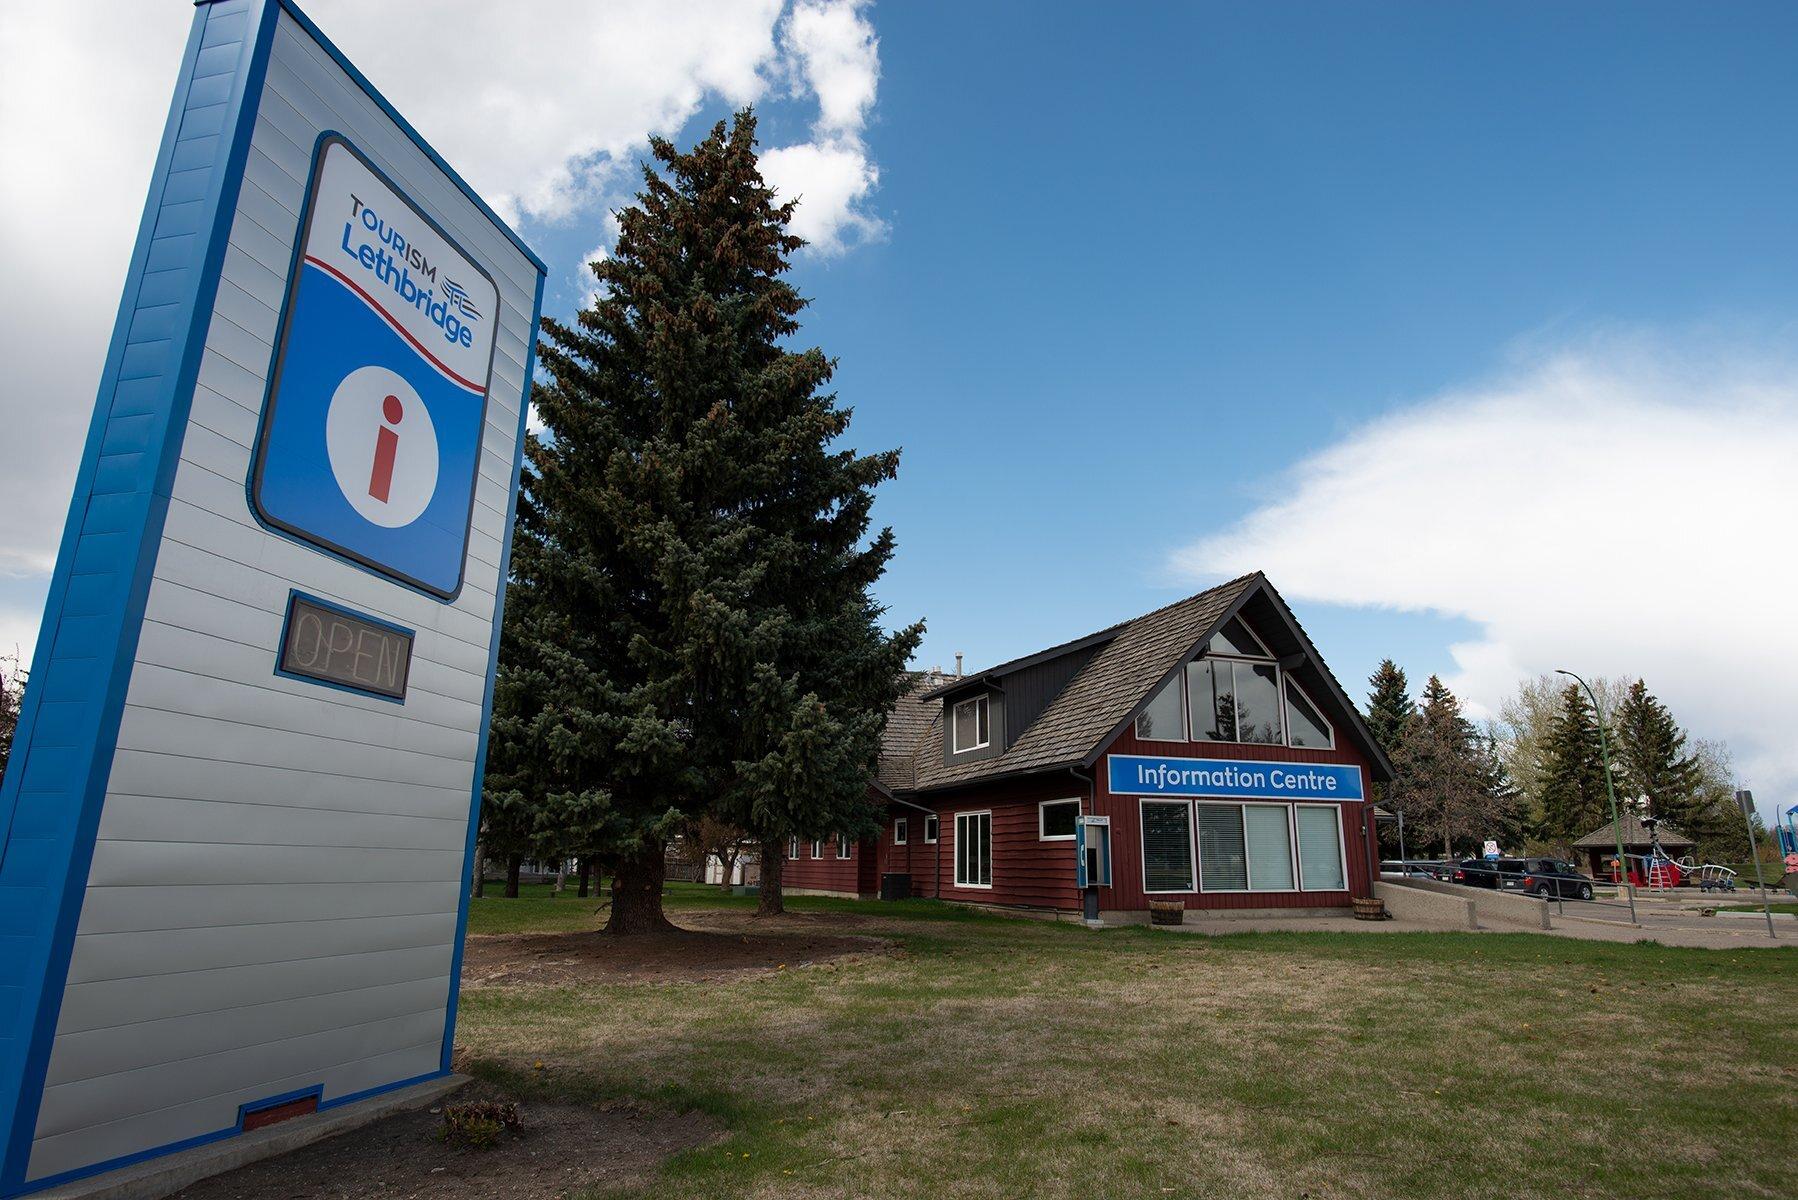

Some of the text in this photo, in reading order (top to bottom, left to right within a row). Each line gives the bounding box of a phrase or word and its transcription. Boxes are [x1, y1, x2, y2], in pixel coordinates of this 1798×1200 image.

[350, 193, 437, 283] TOURISM
[341, 222, 473, 348] Lethbridge
[295, 613, 401, 688] OPEN
[1137, 764, 1337, 791] Information Centre
